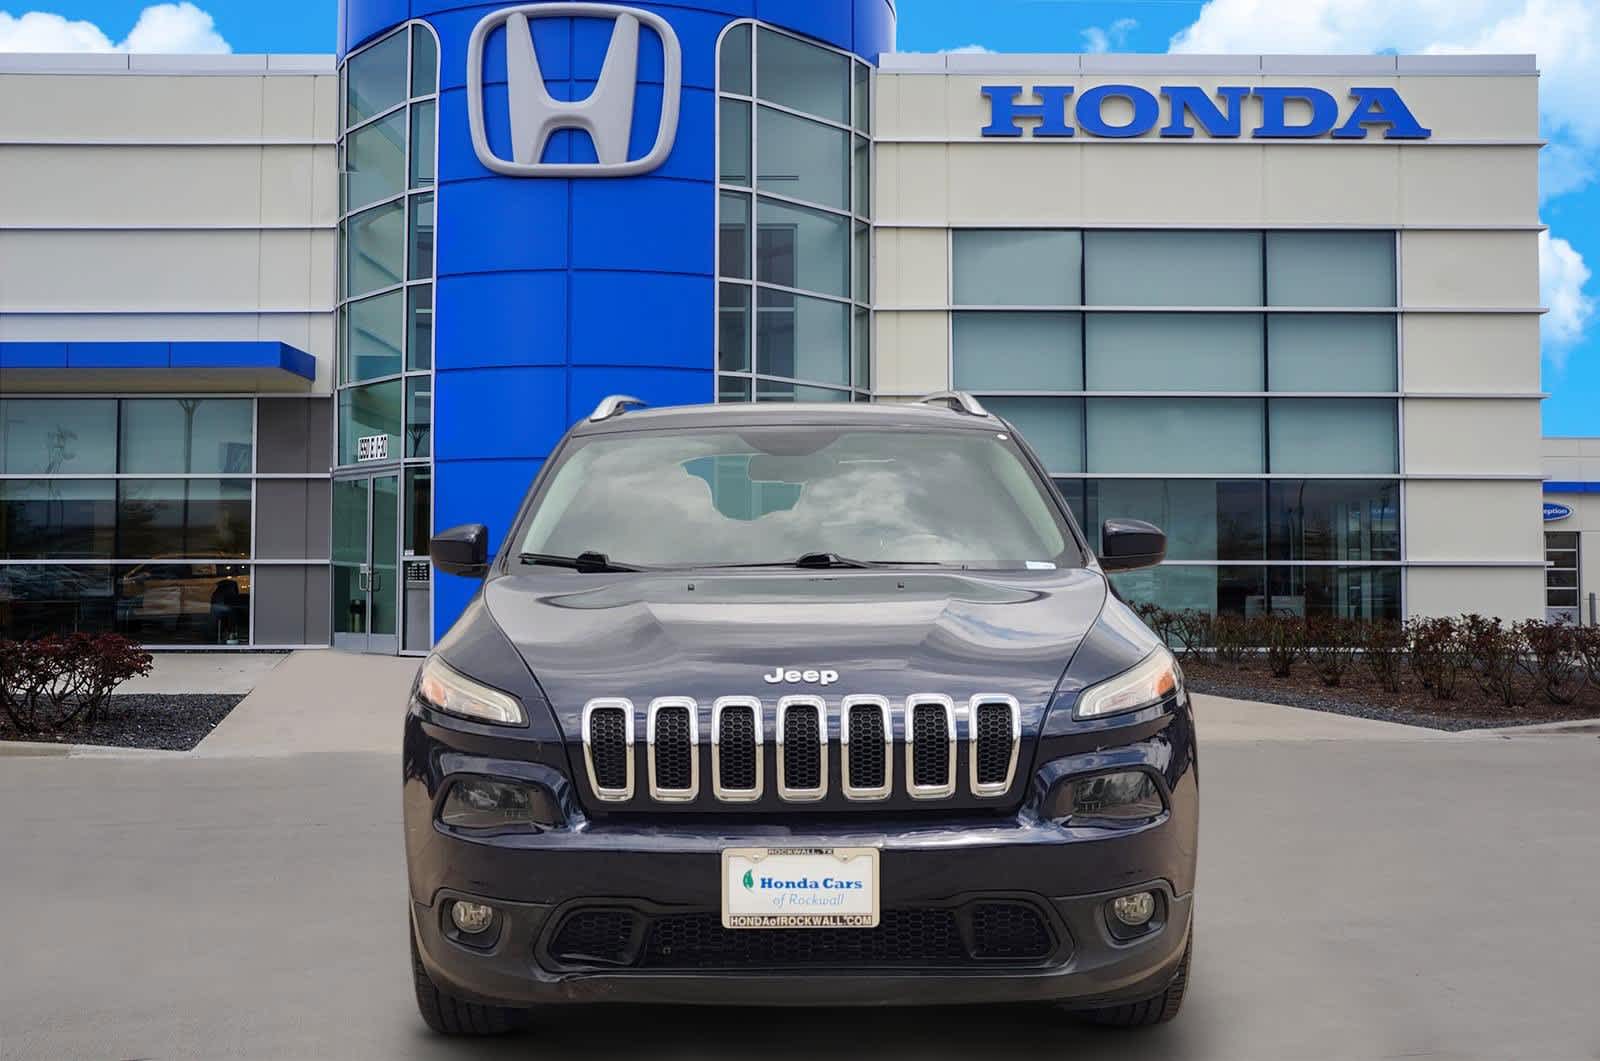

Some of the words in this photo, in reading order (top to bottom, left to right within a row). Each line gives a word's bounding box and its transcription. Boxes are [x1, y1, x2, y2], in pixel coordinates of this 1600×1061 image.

[980, 84, 1432, 138] HONDA
[763, 667, 839, 686] Jeep
[760, 877, 820, 889] Honda
[822, 877, 863, 889] Cars
[772, 892, 786, 909] of
[788, 892, 845, 906] Rockwall
